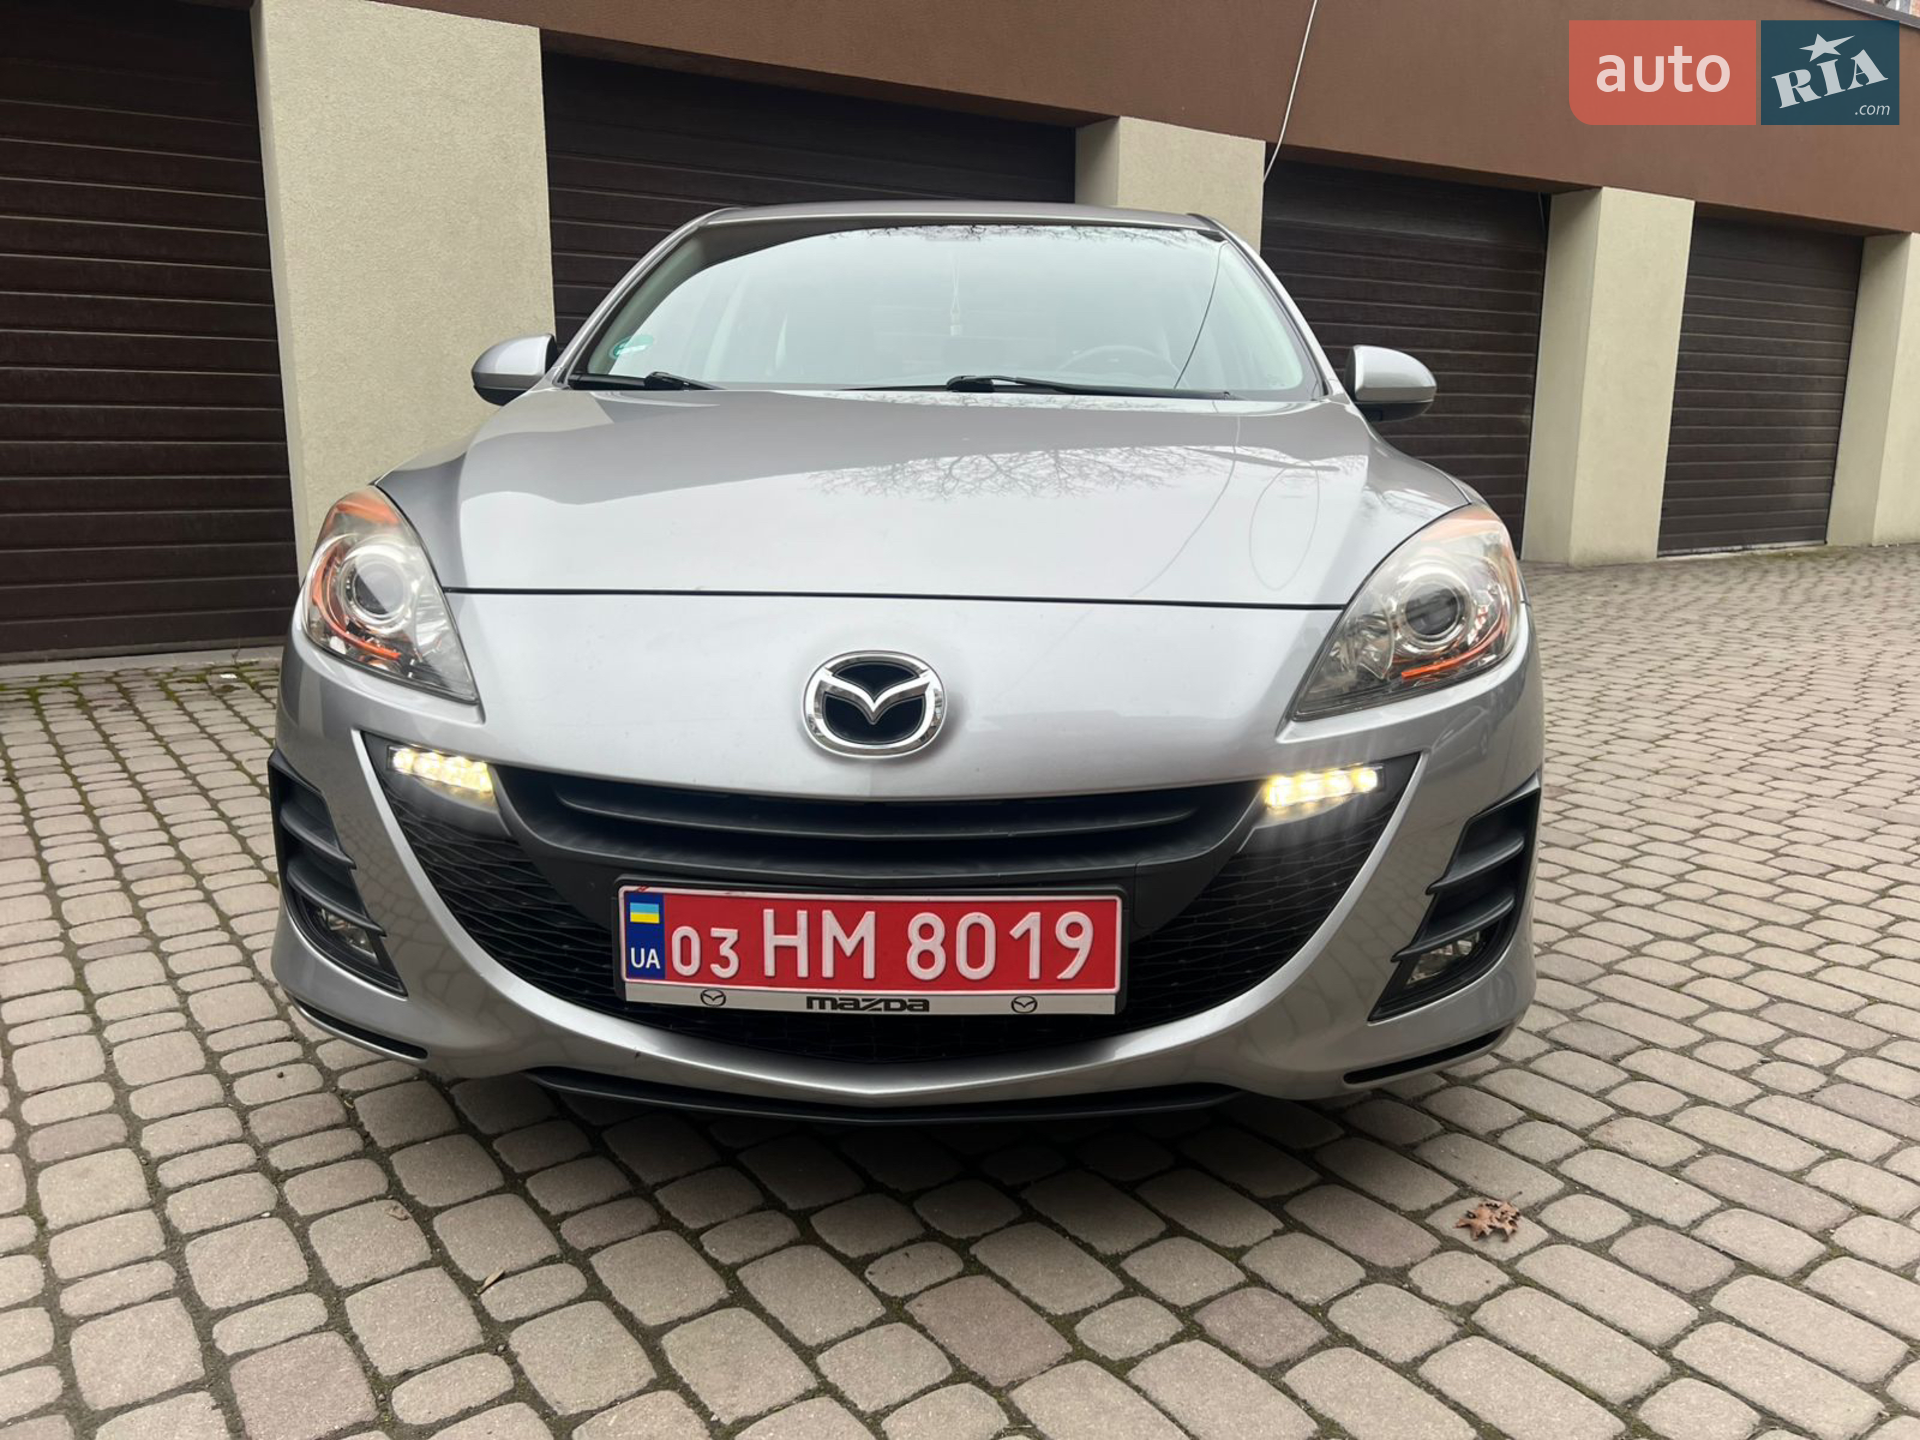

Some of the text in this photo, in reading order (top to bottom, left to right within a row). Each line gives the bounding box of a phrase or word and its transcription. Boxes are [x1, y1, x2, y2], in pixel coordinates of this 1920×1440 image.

[630, 947, 661, 970] UA
[671, 908, 1094, 981] 03 HM 8019
